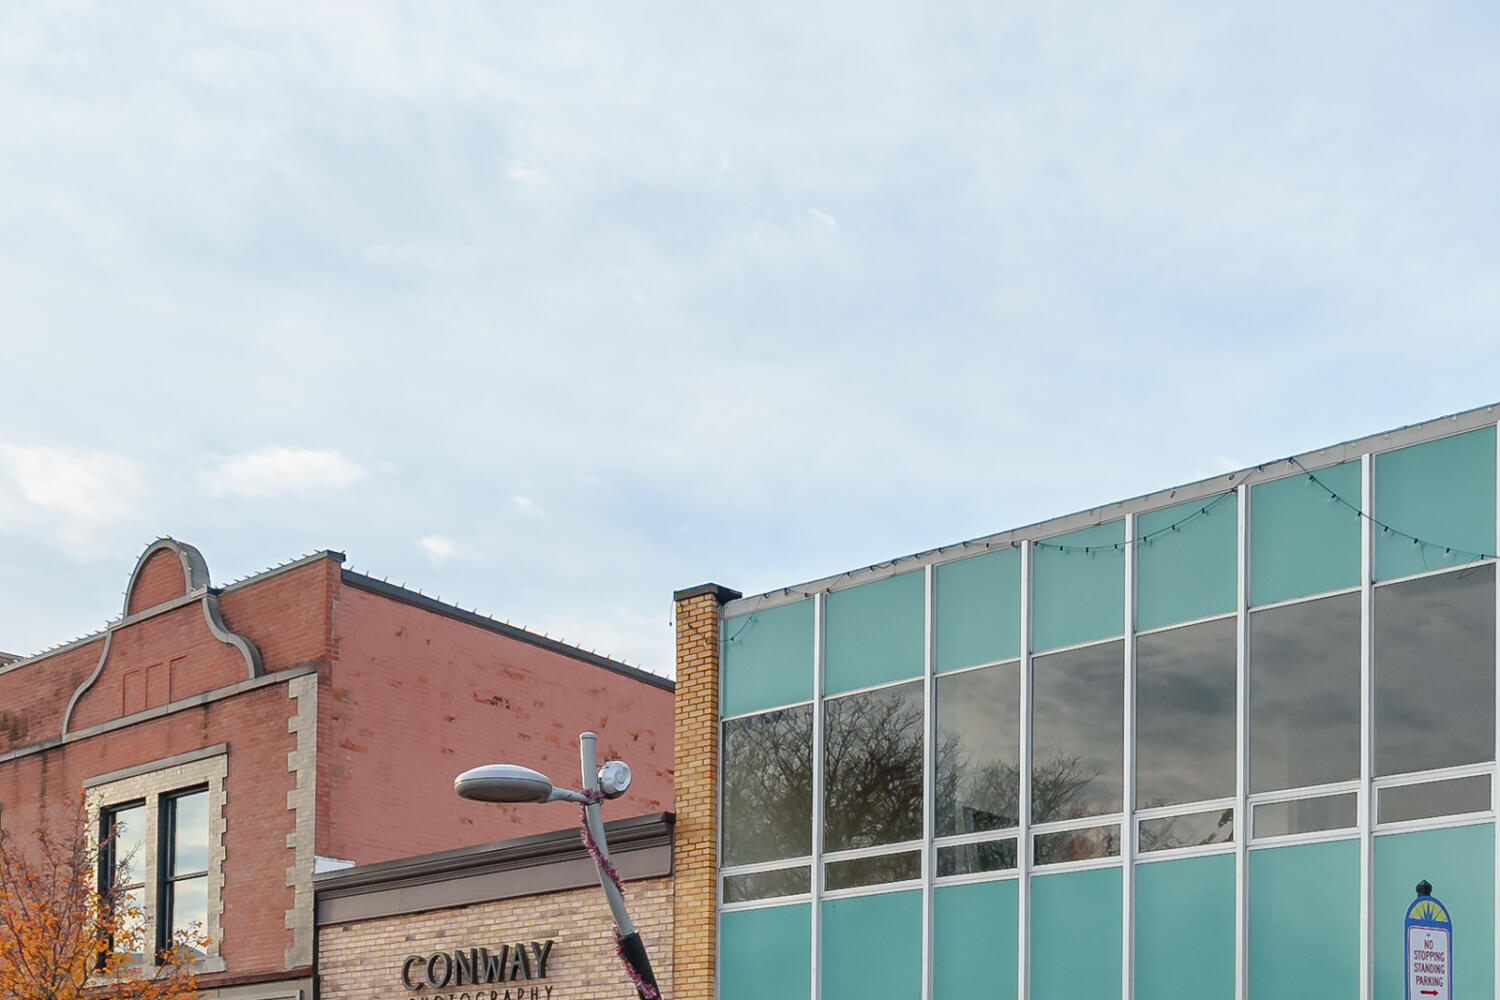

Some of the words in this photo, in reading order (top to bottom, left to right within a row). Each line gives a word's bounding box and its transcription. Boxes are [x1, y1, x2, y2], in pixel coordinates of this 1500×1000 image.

[1424, 939, 1434, 950] NO
[1414, 950, 1446, 962] STOPPING
[401, 940, 554, 991] CONWAY
[1414, 962, 1446, 975] STANDING
[1415, 975, 1444, 988] PARKING
